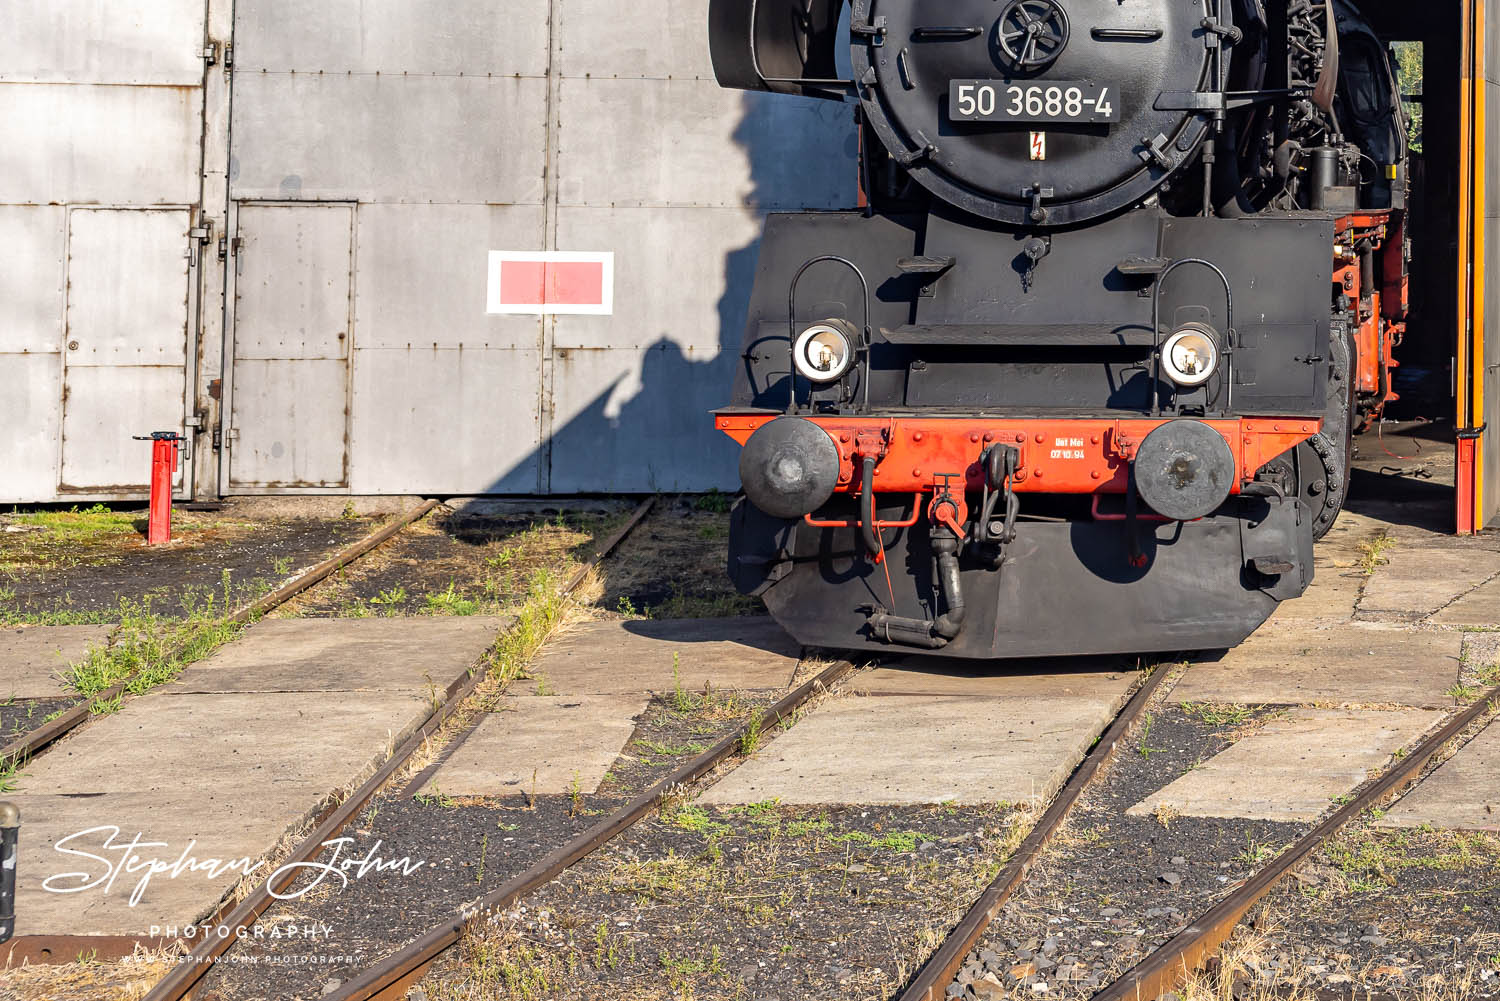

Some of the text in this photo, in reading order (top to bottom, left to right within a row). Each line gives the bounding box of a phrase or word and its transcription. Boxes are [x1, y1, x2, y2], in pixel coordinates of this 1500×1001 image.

[958, 85, 1113, 117] 50 3688-4
[1070, 437, 1084, 447] Mei
